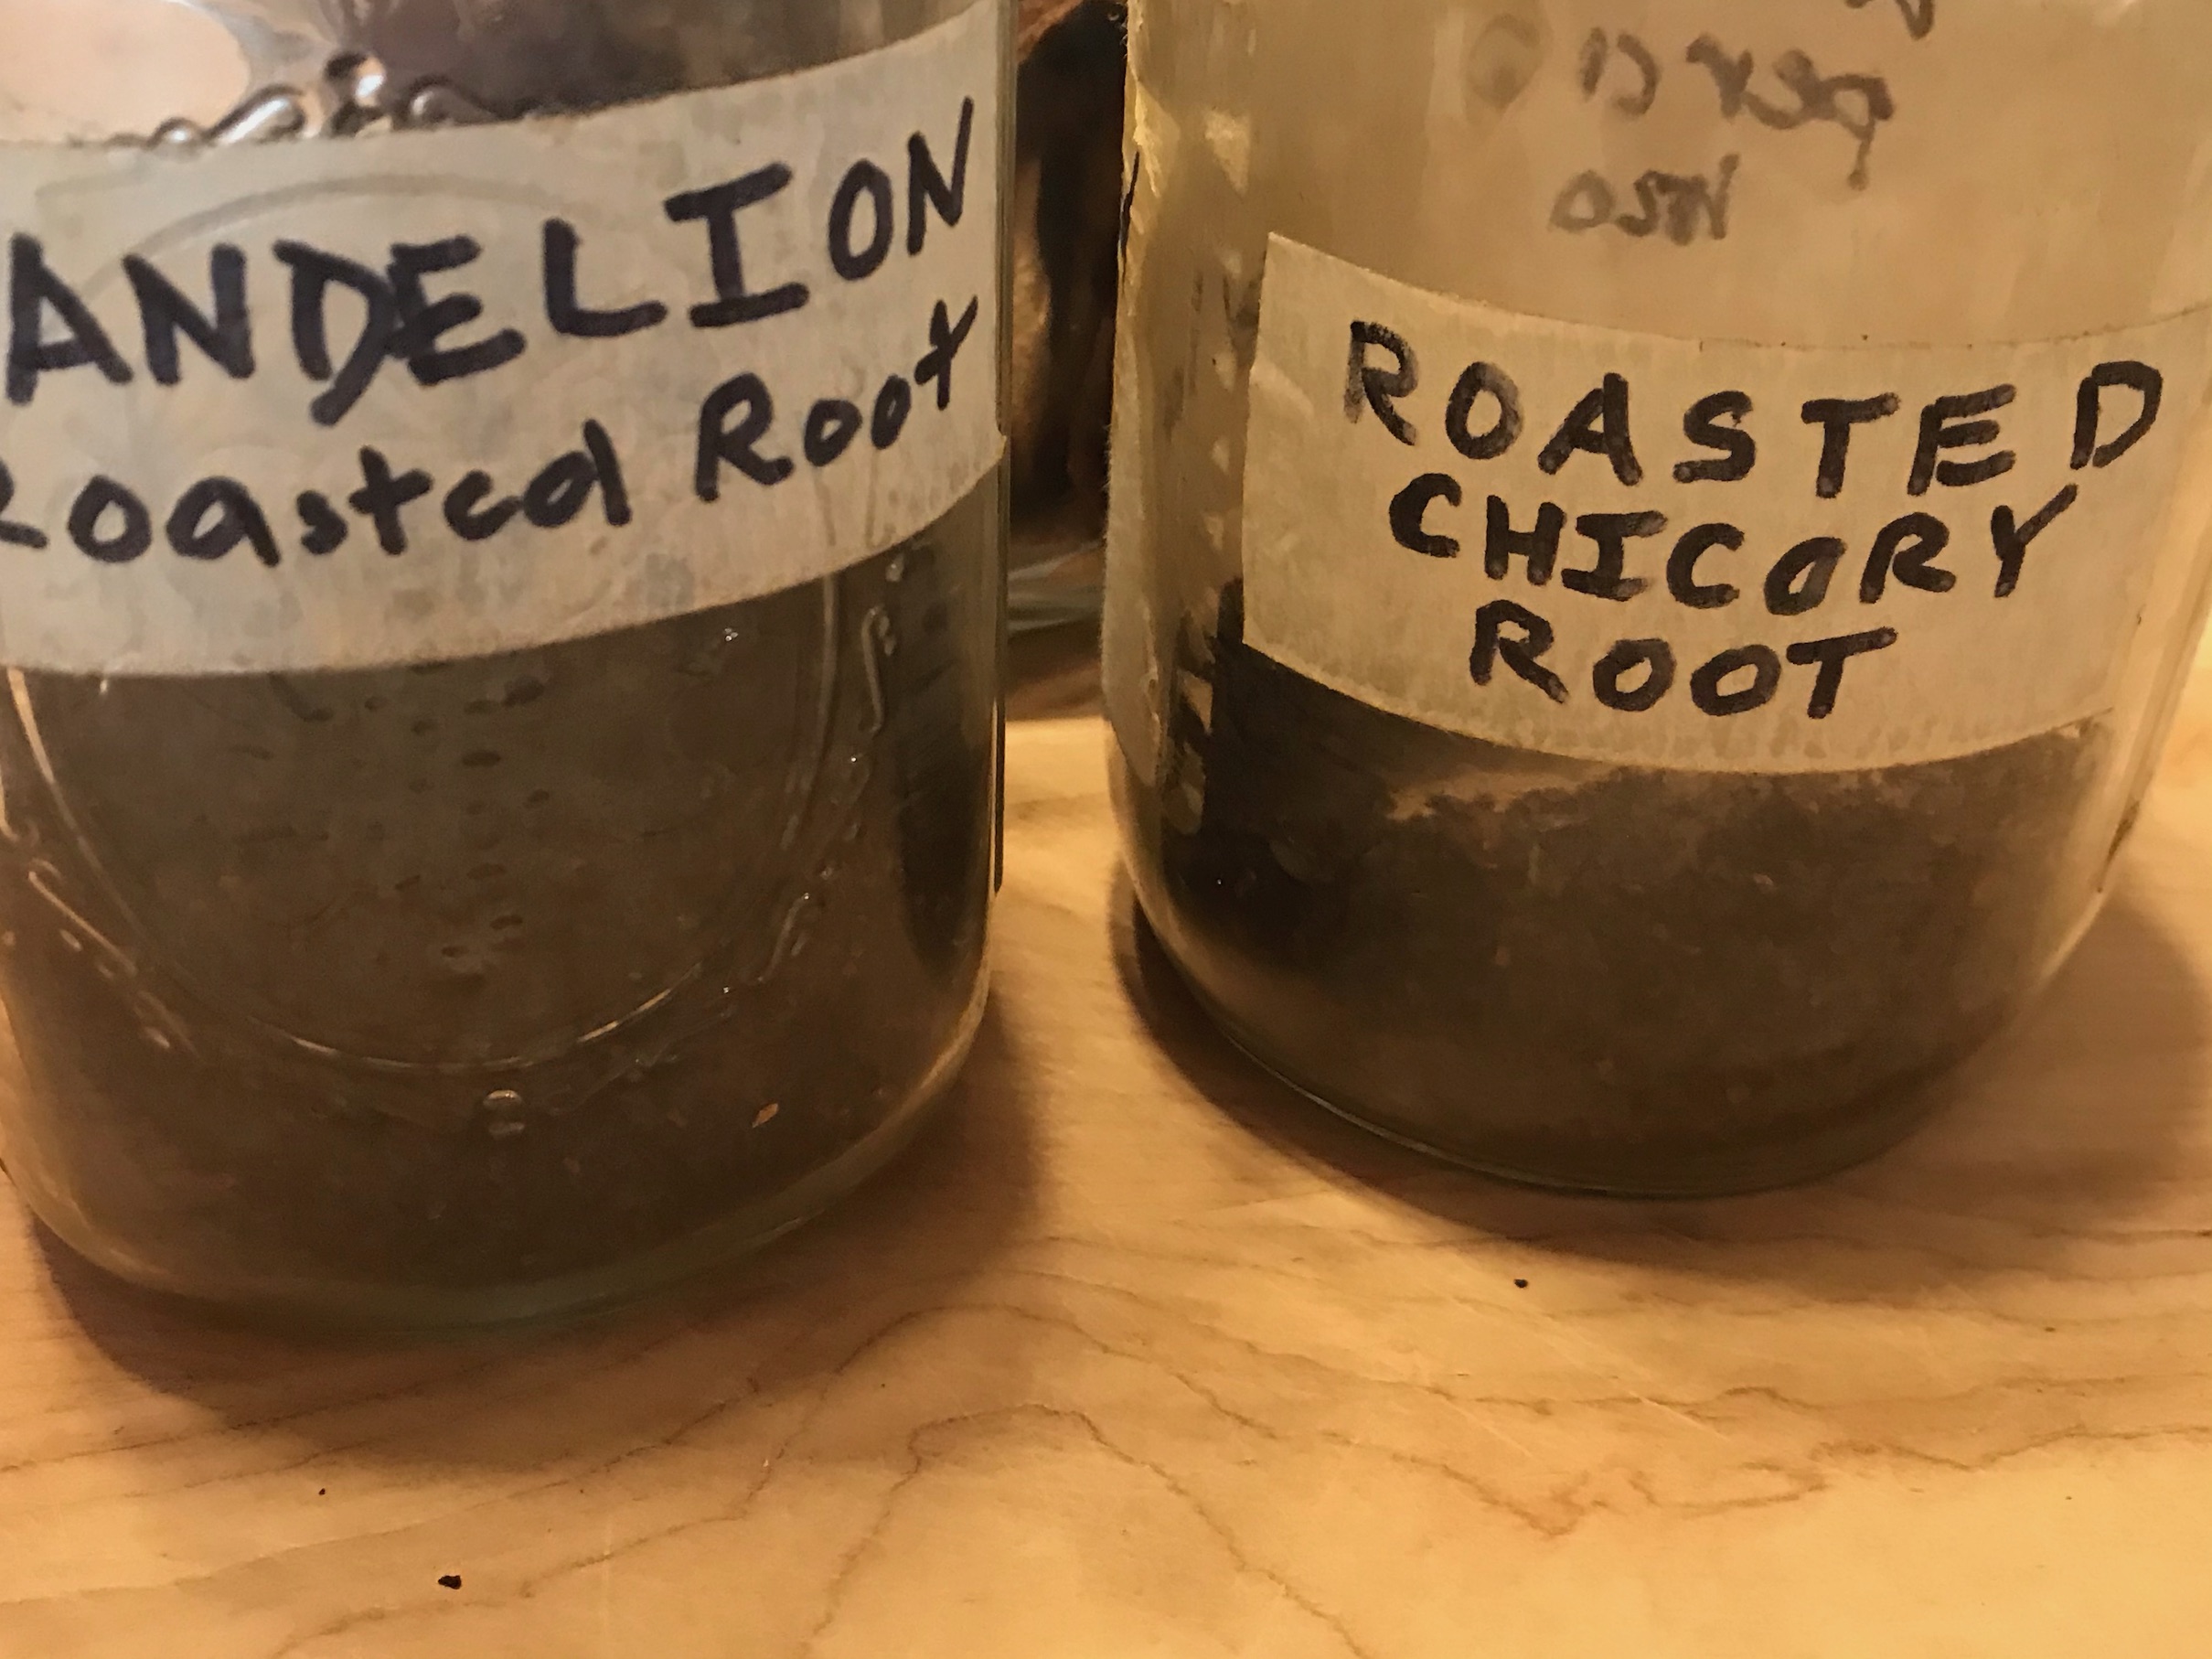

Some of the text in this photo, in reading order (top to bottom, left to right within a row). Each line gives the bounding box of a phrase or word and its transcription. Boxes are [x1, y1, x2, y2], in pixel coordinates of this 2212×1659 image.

[6, 96, 976, 425] ANDELION
[692, 294, 978, 503] Root
[1345, 320, 2163, 497] ROASTED
[1388, 472, 2078, 615] CHICORY
[1469, 599, 1898, 720] ROOT
